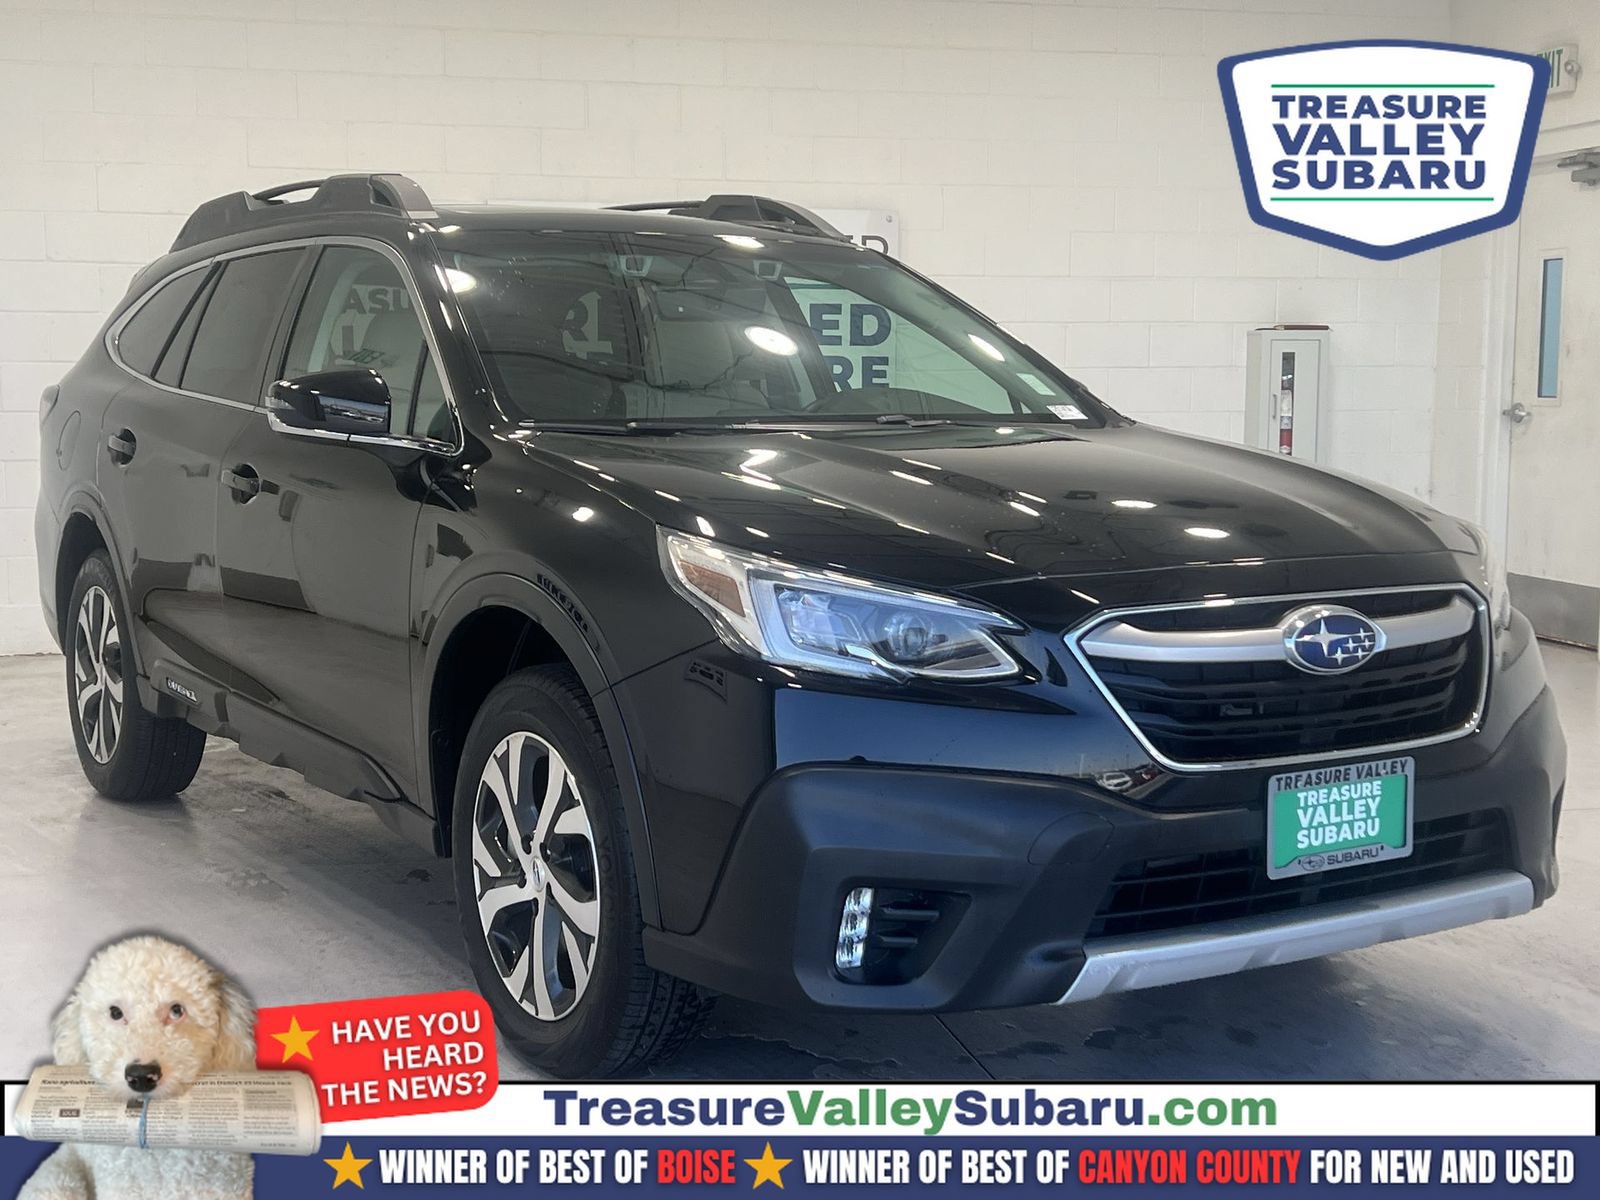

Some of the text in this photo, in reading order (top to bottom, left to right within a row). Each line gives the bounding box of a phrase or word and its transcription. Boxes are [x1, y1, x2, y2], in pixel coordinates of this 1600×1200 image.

[1537, 48, 1564, 89] IT
[1275, 759, 1408, 791] TREASURE VALLEY
[1296, 780, 1382, 807] TREASURE
[1296, 797, 1381, 828] VALLEY
[1296, 818, 1380, 849] SUBARU
[1326, 847, 1380, 865] SUBARU
